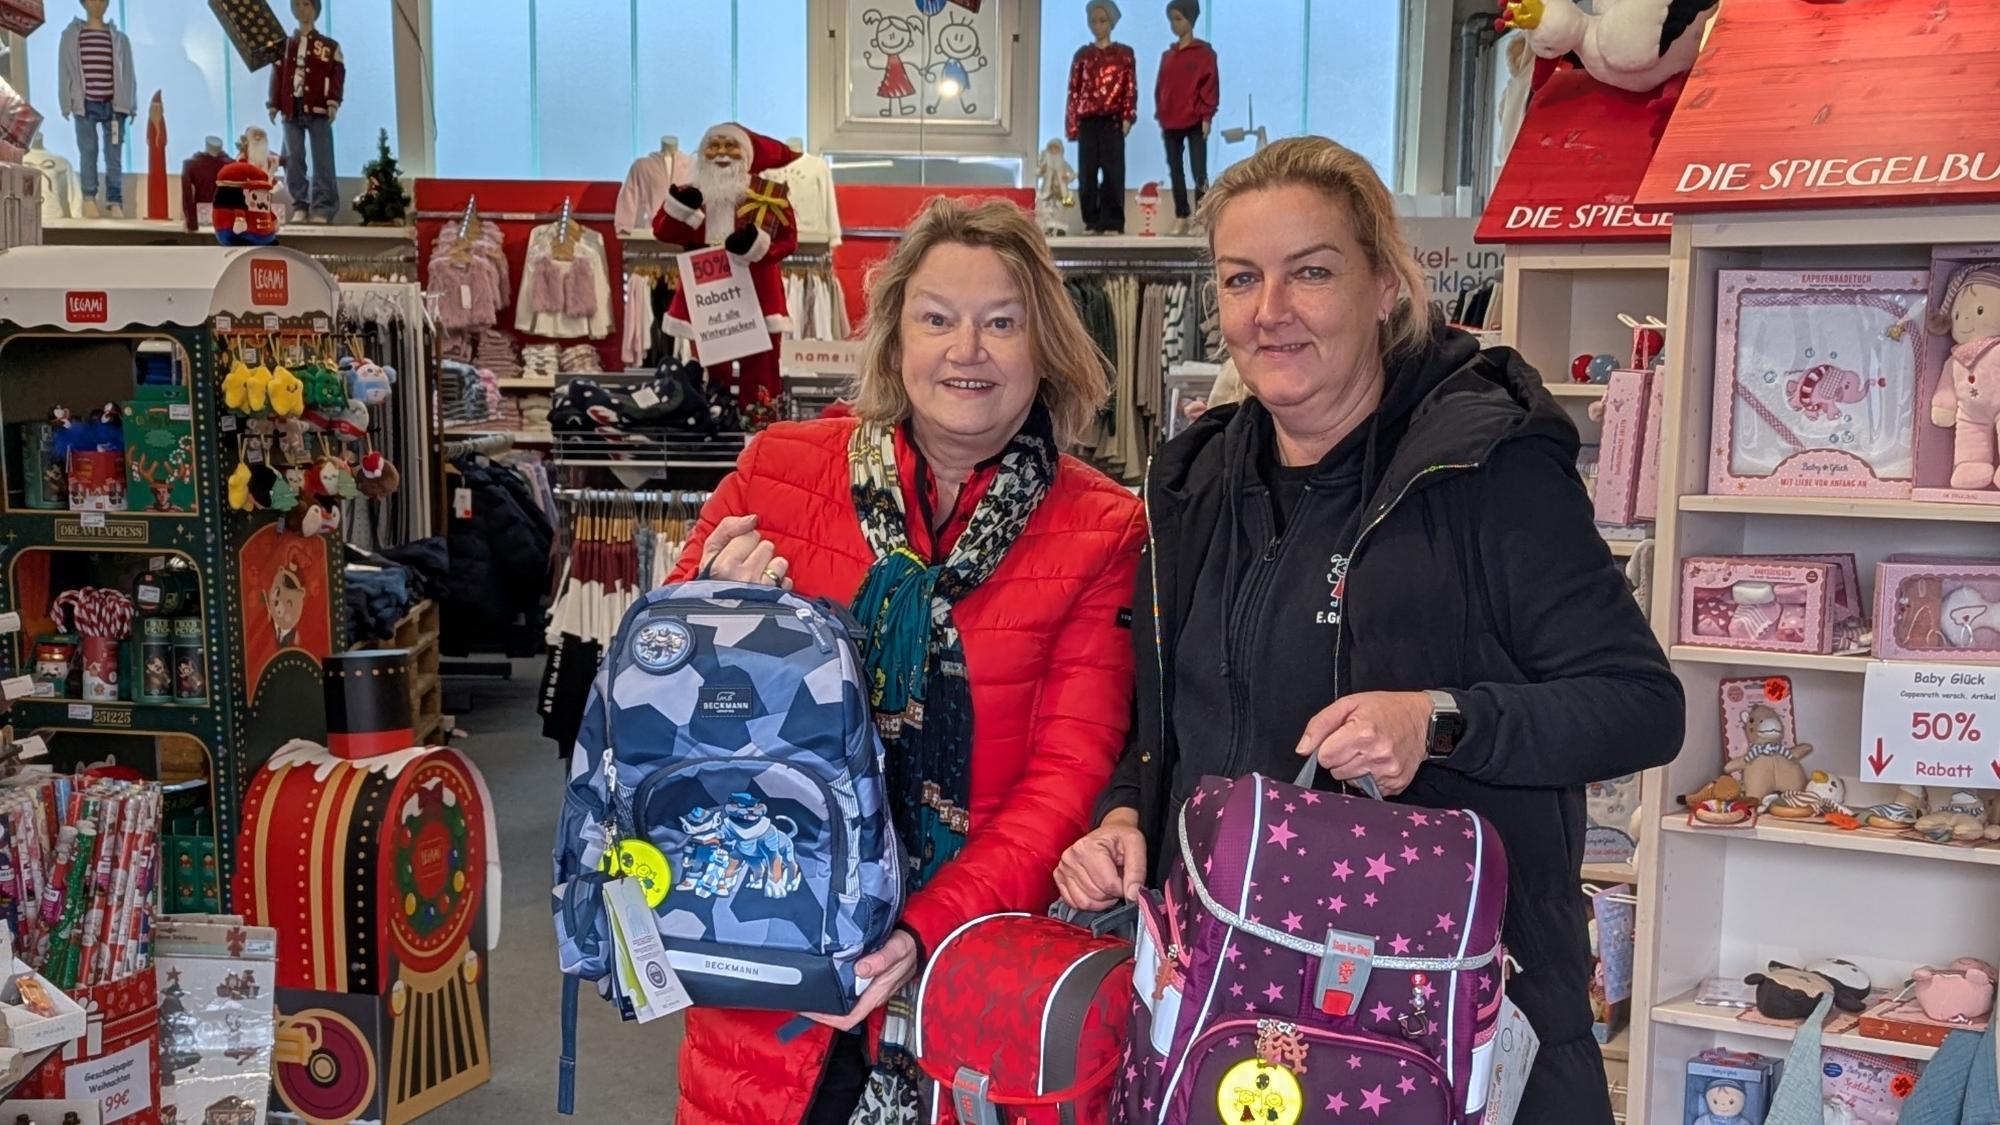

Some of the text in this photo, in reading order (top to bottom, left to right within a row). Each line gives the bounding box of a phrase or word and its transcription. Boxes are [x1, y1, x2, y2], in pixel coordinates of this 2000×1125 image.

[1675, 163, 1751, 192] DIE
[1505, 206, 1563, 229] DIE
[693, 255, 731, 279] 50%
[695, 286, 741, 307] Rabatt
[708, 309, 741, 324] Auf alle
[795, 352, 839, 362] name
[98, 526, 143, 537] EXPRESS
[1914, 672, 1985, 686] Baby Glück
[1900, 690, 1939, 699] Coppenrath
[703, 702, 749, 710] BECKMANN
[93, 711, 131, 723] 251225
[1912, 712, 1981, 741] 50%
[1916, 761, 1973, 778] Rabatt
[705, 961, 759, 976] BECKMANN
